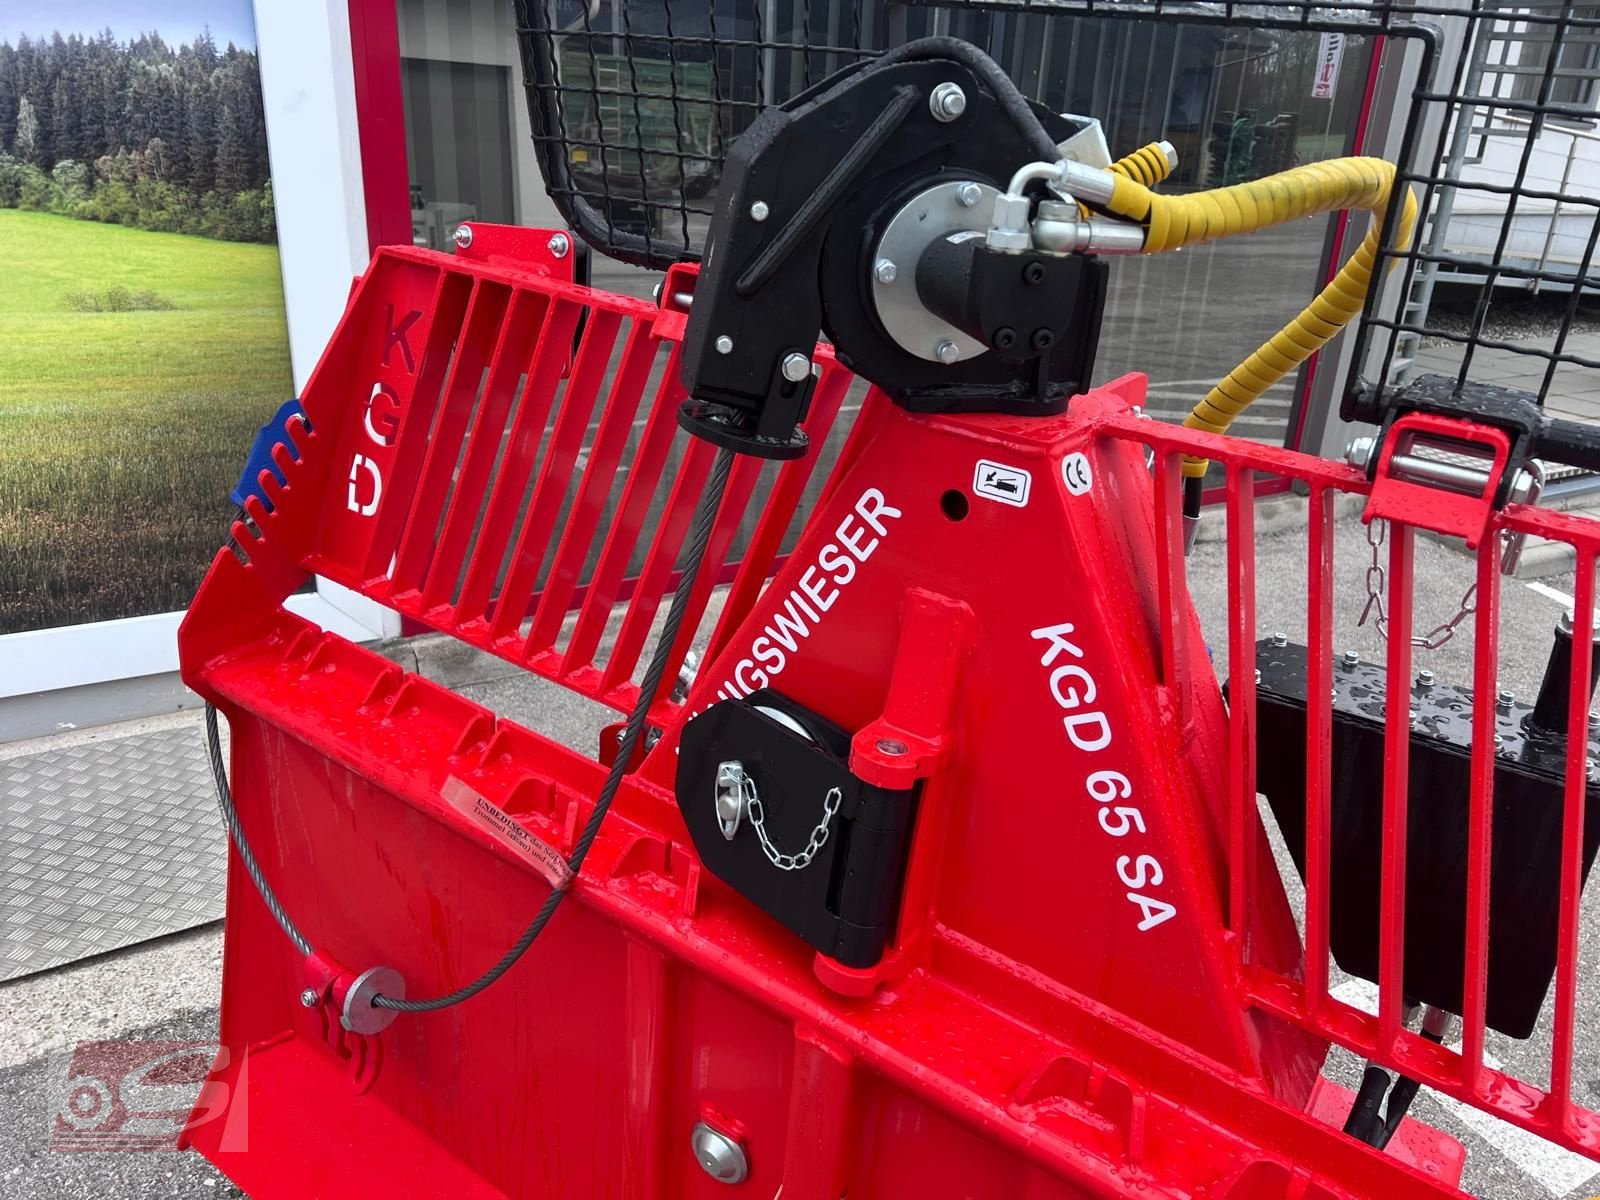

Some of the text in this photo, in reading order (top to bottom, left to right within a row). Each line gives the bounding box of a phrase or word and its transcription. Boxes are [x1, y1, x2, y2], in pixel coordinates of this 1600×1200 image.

[688, 487, 902, 724] IGSWIESER
[473, 806, 505, 833] Trommel
[532, 850, 546, 863] und
[477, 798, 529, 840] UNBEDINGT
[530, 838, 543, 850] das
[1030, 622, 1177, 932] KGD 65 SA
